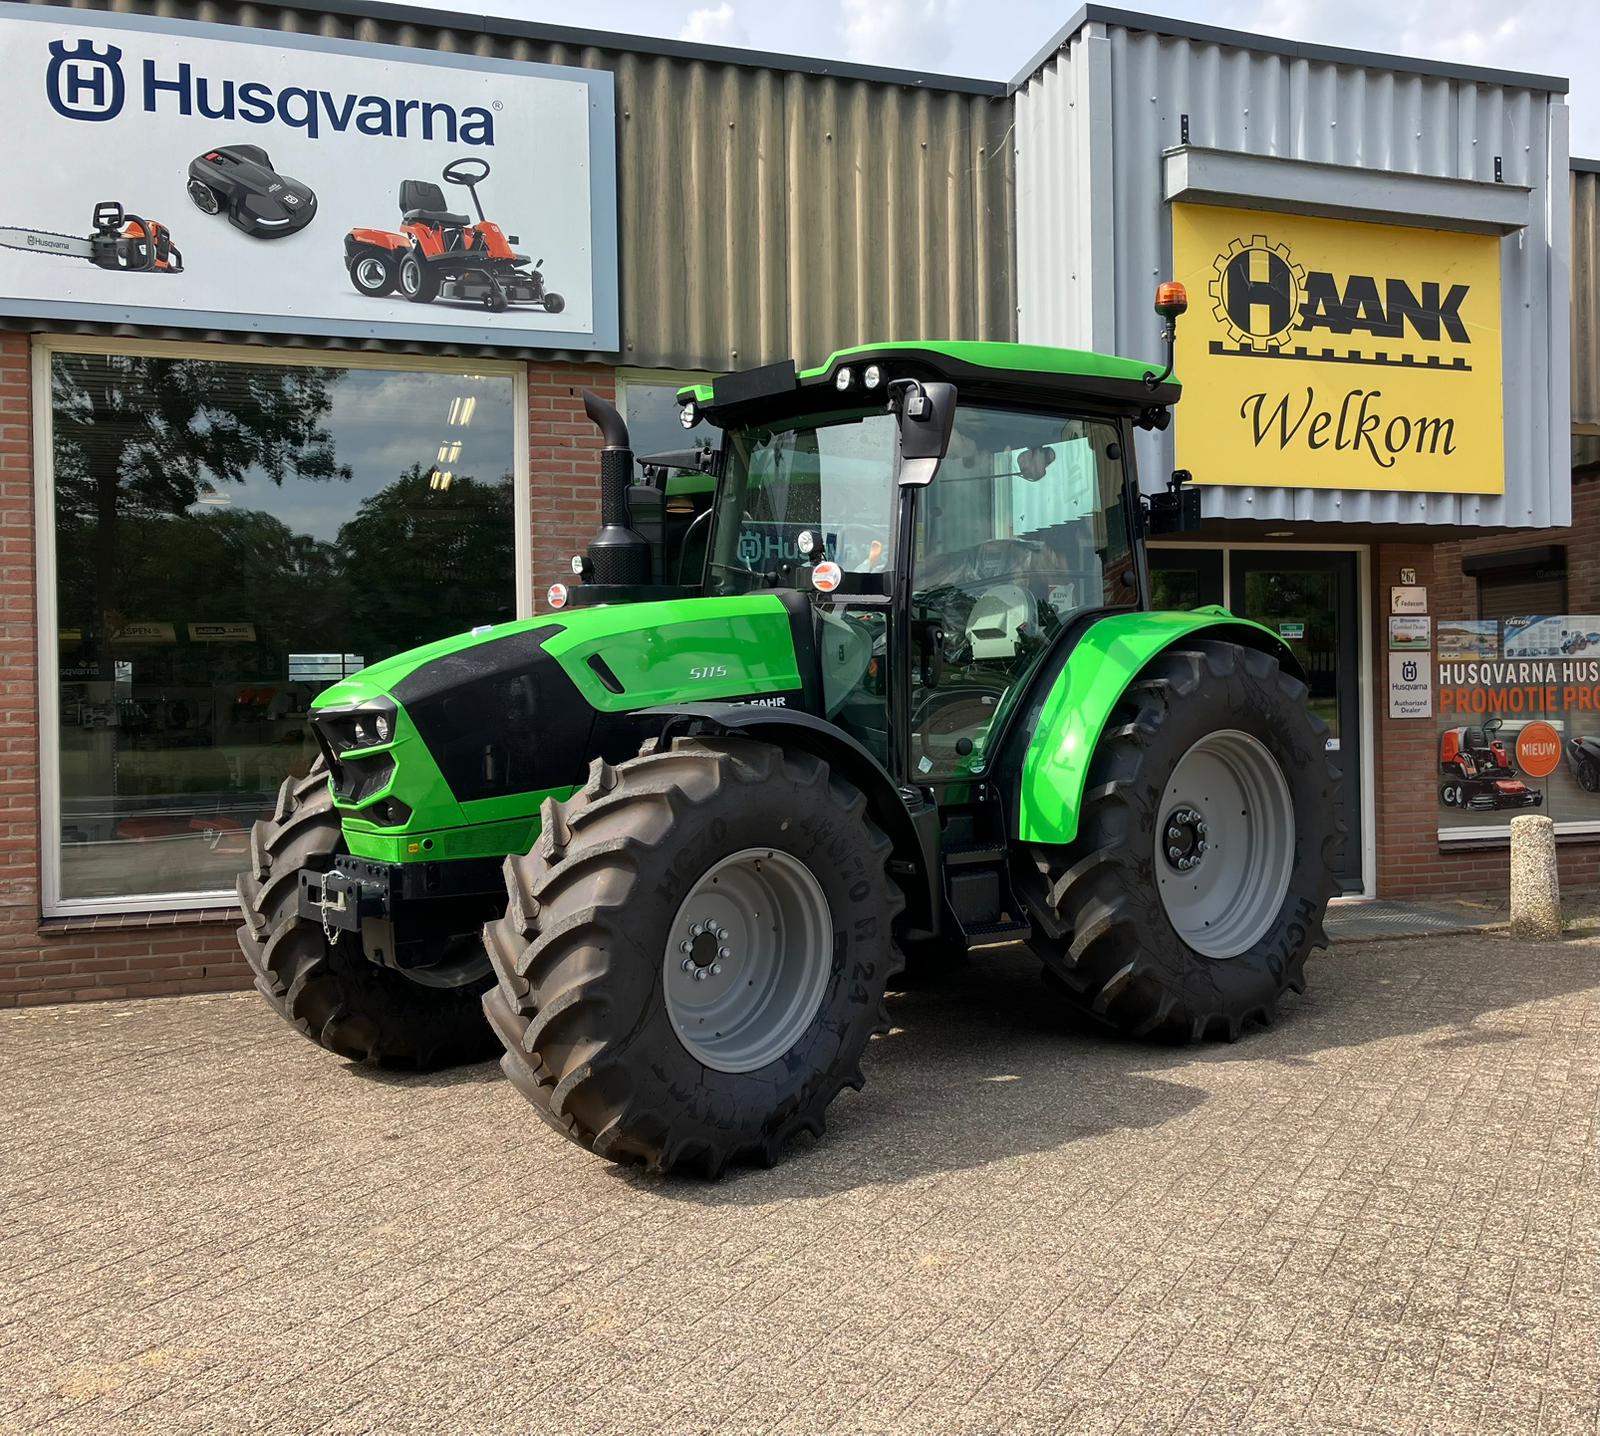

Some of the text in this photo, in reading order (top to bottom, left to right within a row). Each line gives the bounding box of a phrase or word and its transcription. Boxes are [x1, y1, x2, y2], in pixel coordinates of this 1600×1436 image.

[143, 59, 495, 146] Husqvarna
[35, 238, 70, 250] Husqvarna
[1226, 248, 1472, 344] HAANK
[1240, 387, 1457, 468] Welkom
[1401, 570, 1415, 582] 267
[688, 664, 728, 680] 5115
[1439, 661, 1599, 686] HUSQVARNA HUS
[1392, 683, 1428, 691] Husqvarna
[1394, 699, 1427, 707] Authorized
[1439, 686, 1558, 714] PROMOTIE
[1521, 742, 1556, 756] NIEUW
